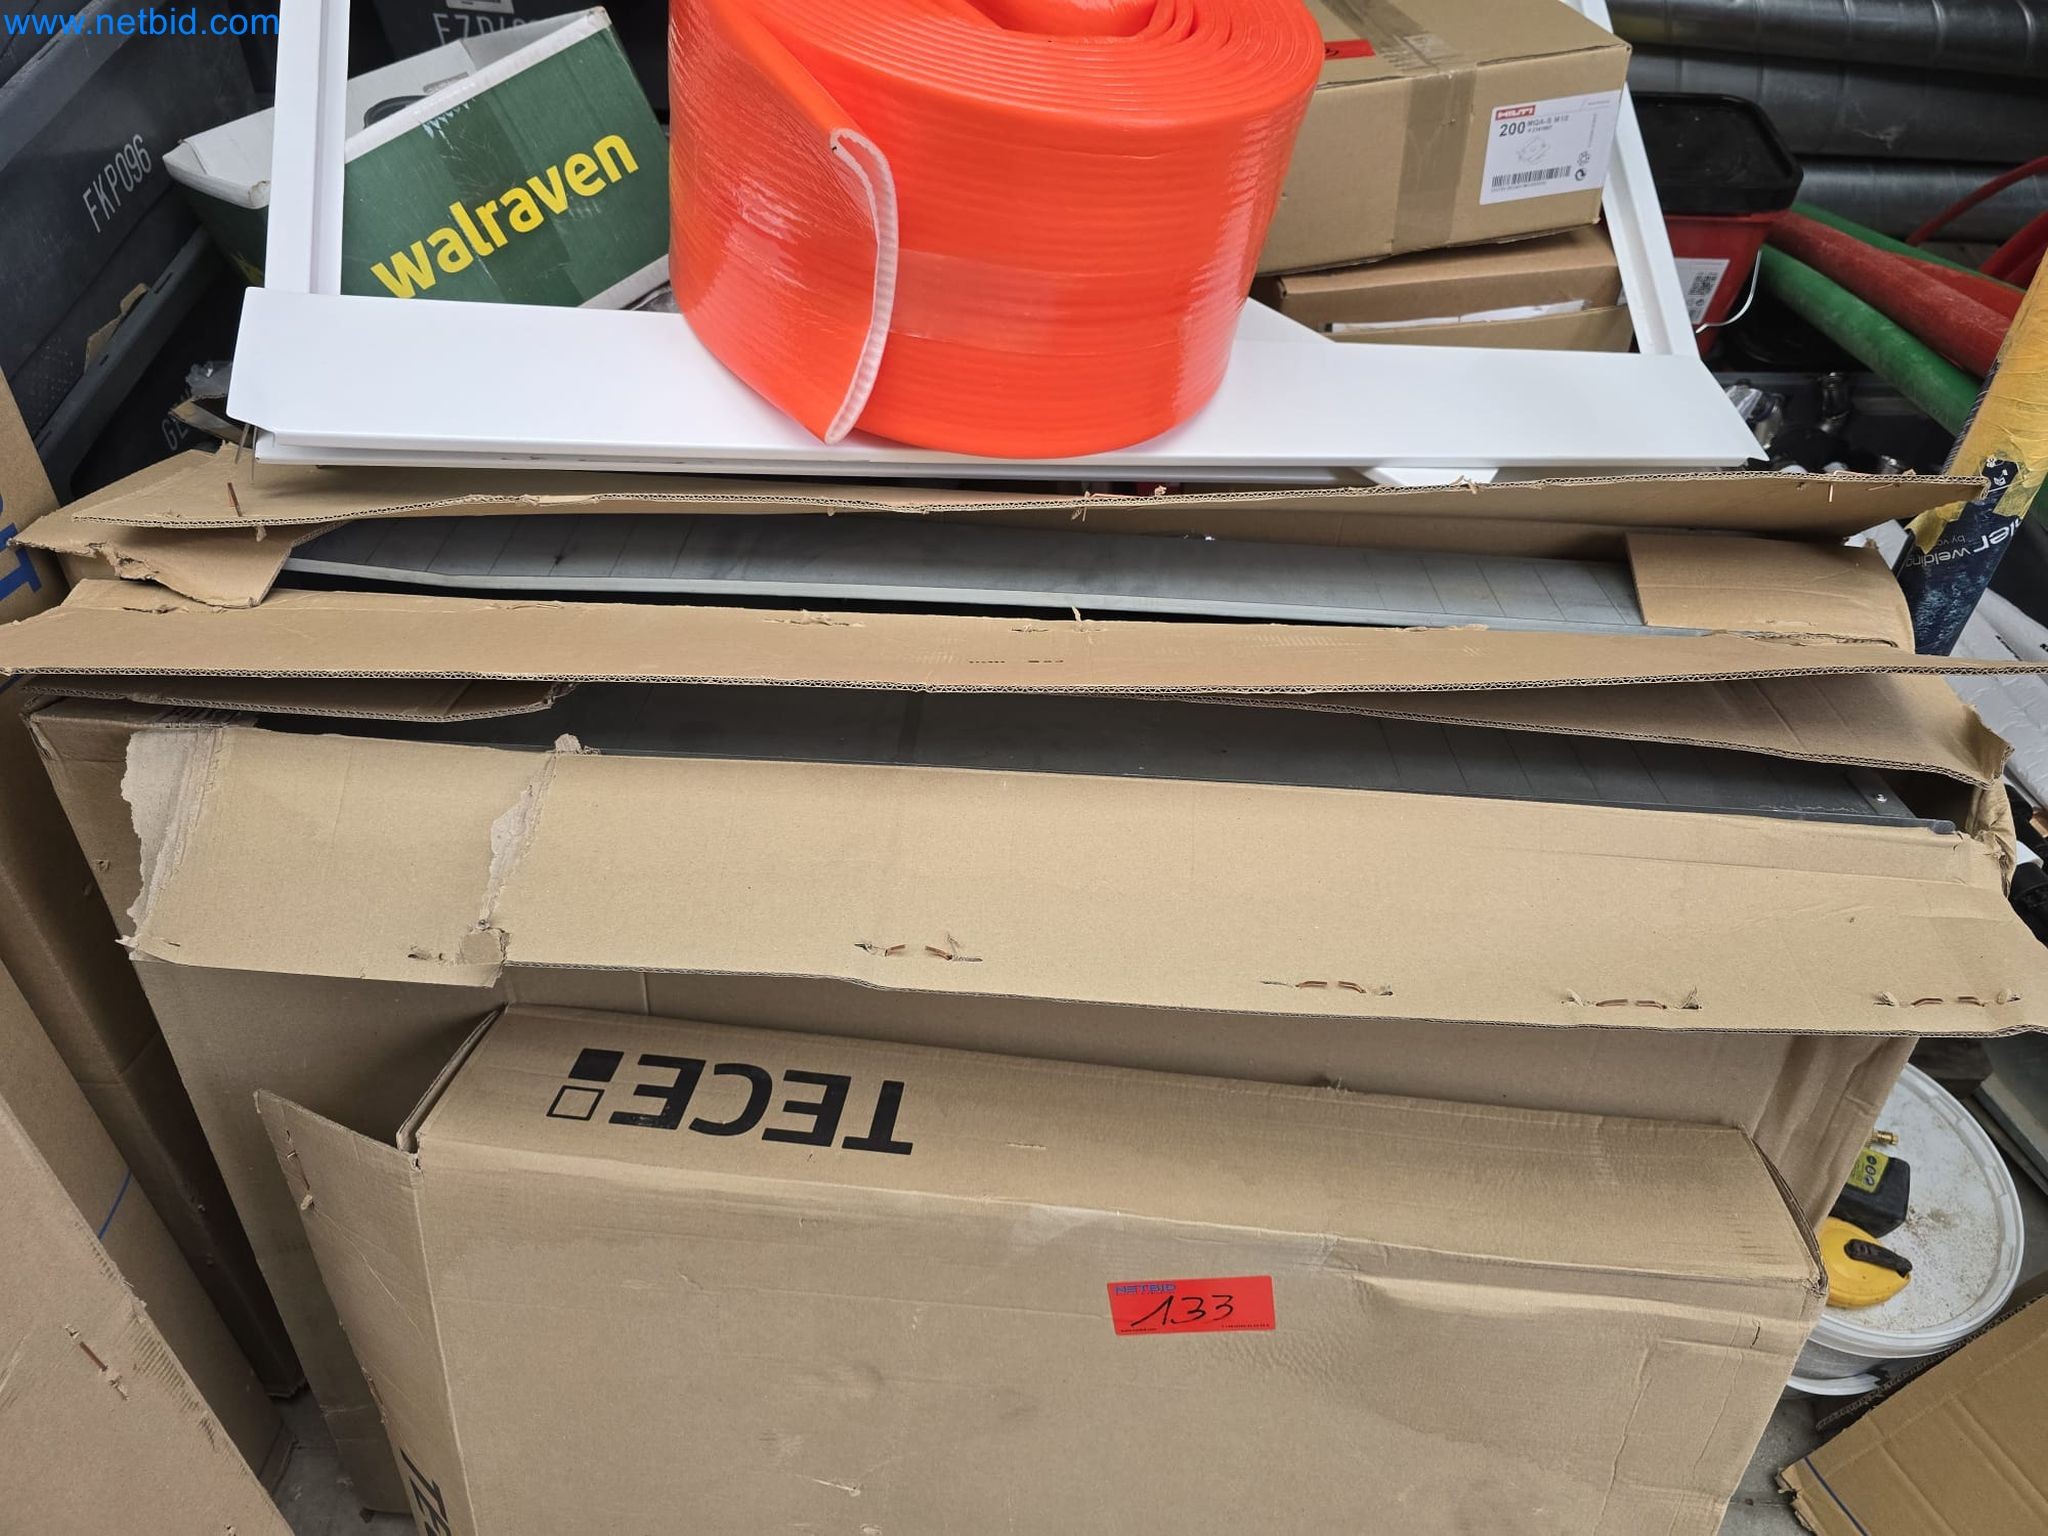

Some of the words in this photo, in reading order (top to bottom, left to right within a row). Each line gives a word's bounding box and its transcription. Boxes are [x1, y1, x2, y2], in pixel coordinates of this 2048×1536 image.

[1499, 121, 1526, 137] 200
[83, 134, 152, 233] FKP096
[370, 134, 640, 299] walraven
[608, 1053, 914, 1156] TECE
[1131, 1295, 1234, 1326] 133
